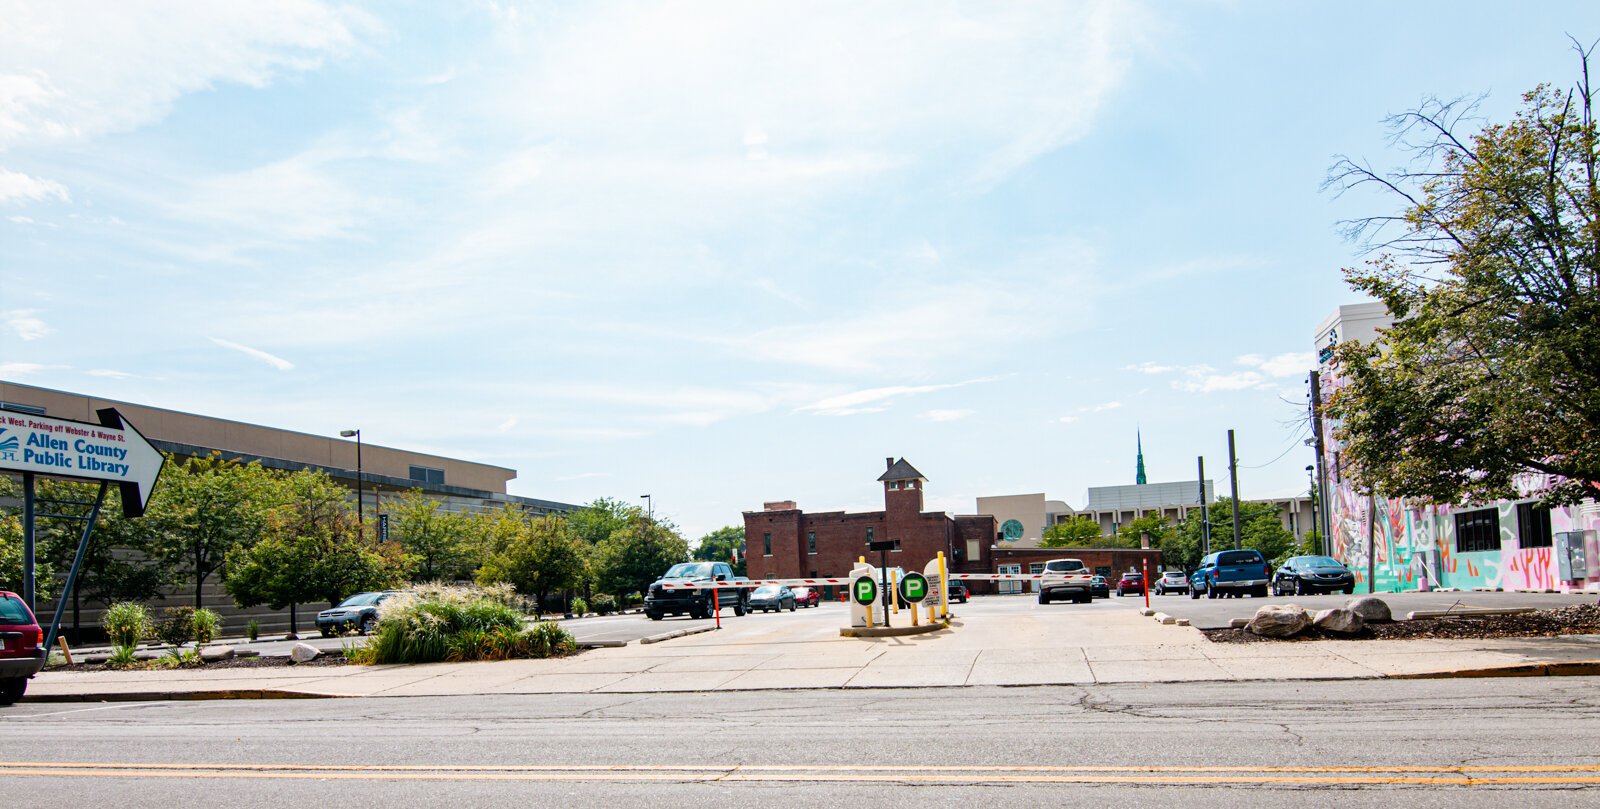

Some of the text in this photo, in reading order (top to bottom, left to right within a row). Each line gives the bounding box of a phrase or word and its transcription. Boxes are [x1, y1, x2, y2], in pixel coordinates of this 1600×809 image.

[8, 417, 27, 427] West.
[28, 420, 53, 432] Parking
[65, 425, 89, 436] Webster
[97, 431, 116, 441] Wayne
[117, 434, 125, 442] St.
[26, 432, 127, 460] Allen County
[24, 448, 129, 476] Public Library
[858, 583, 871, 600] P
[906, 580, 921, 597] P
